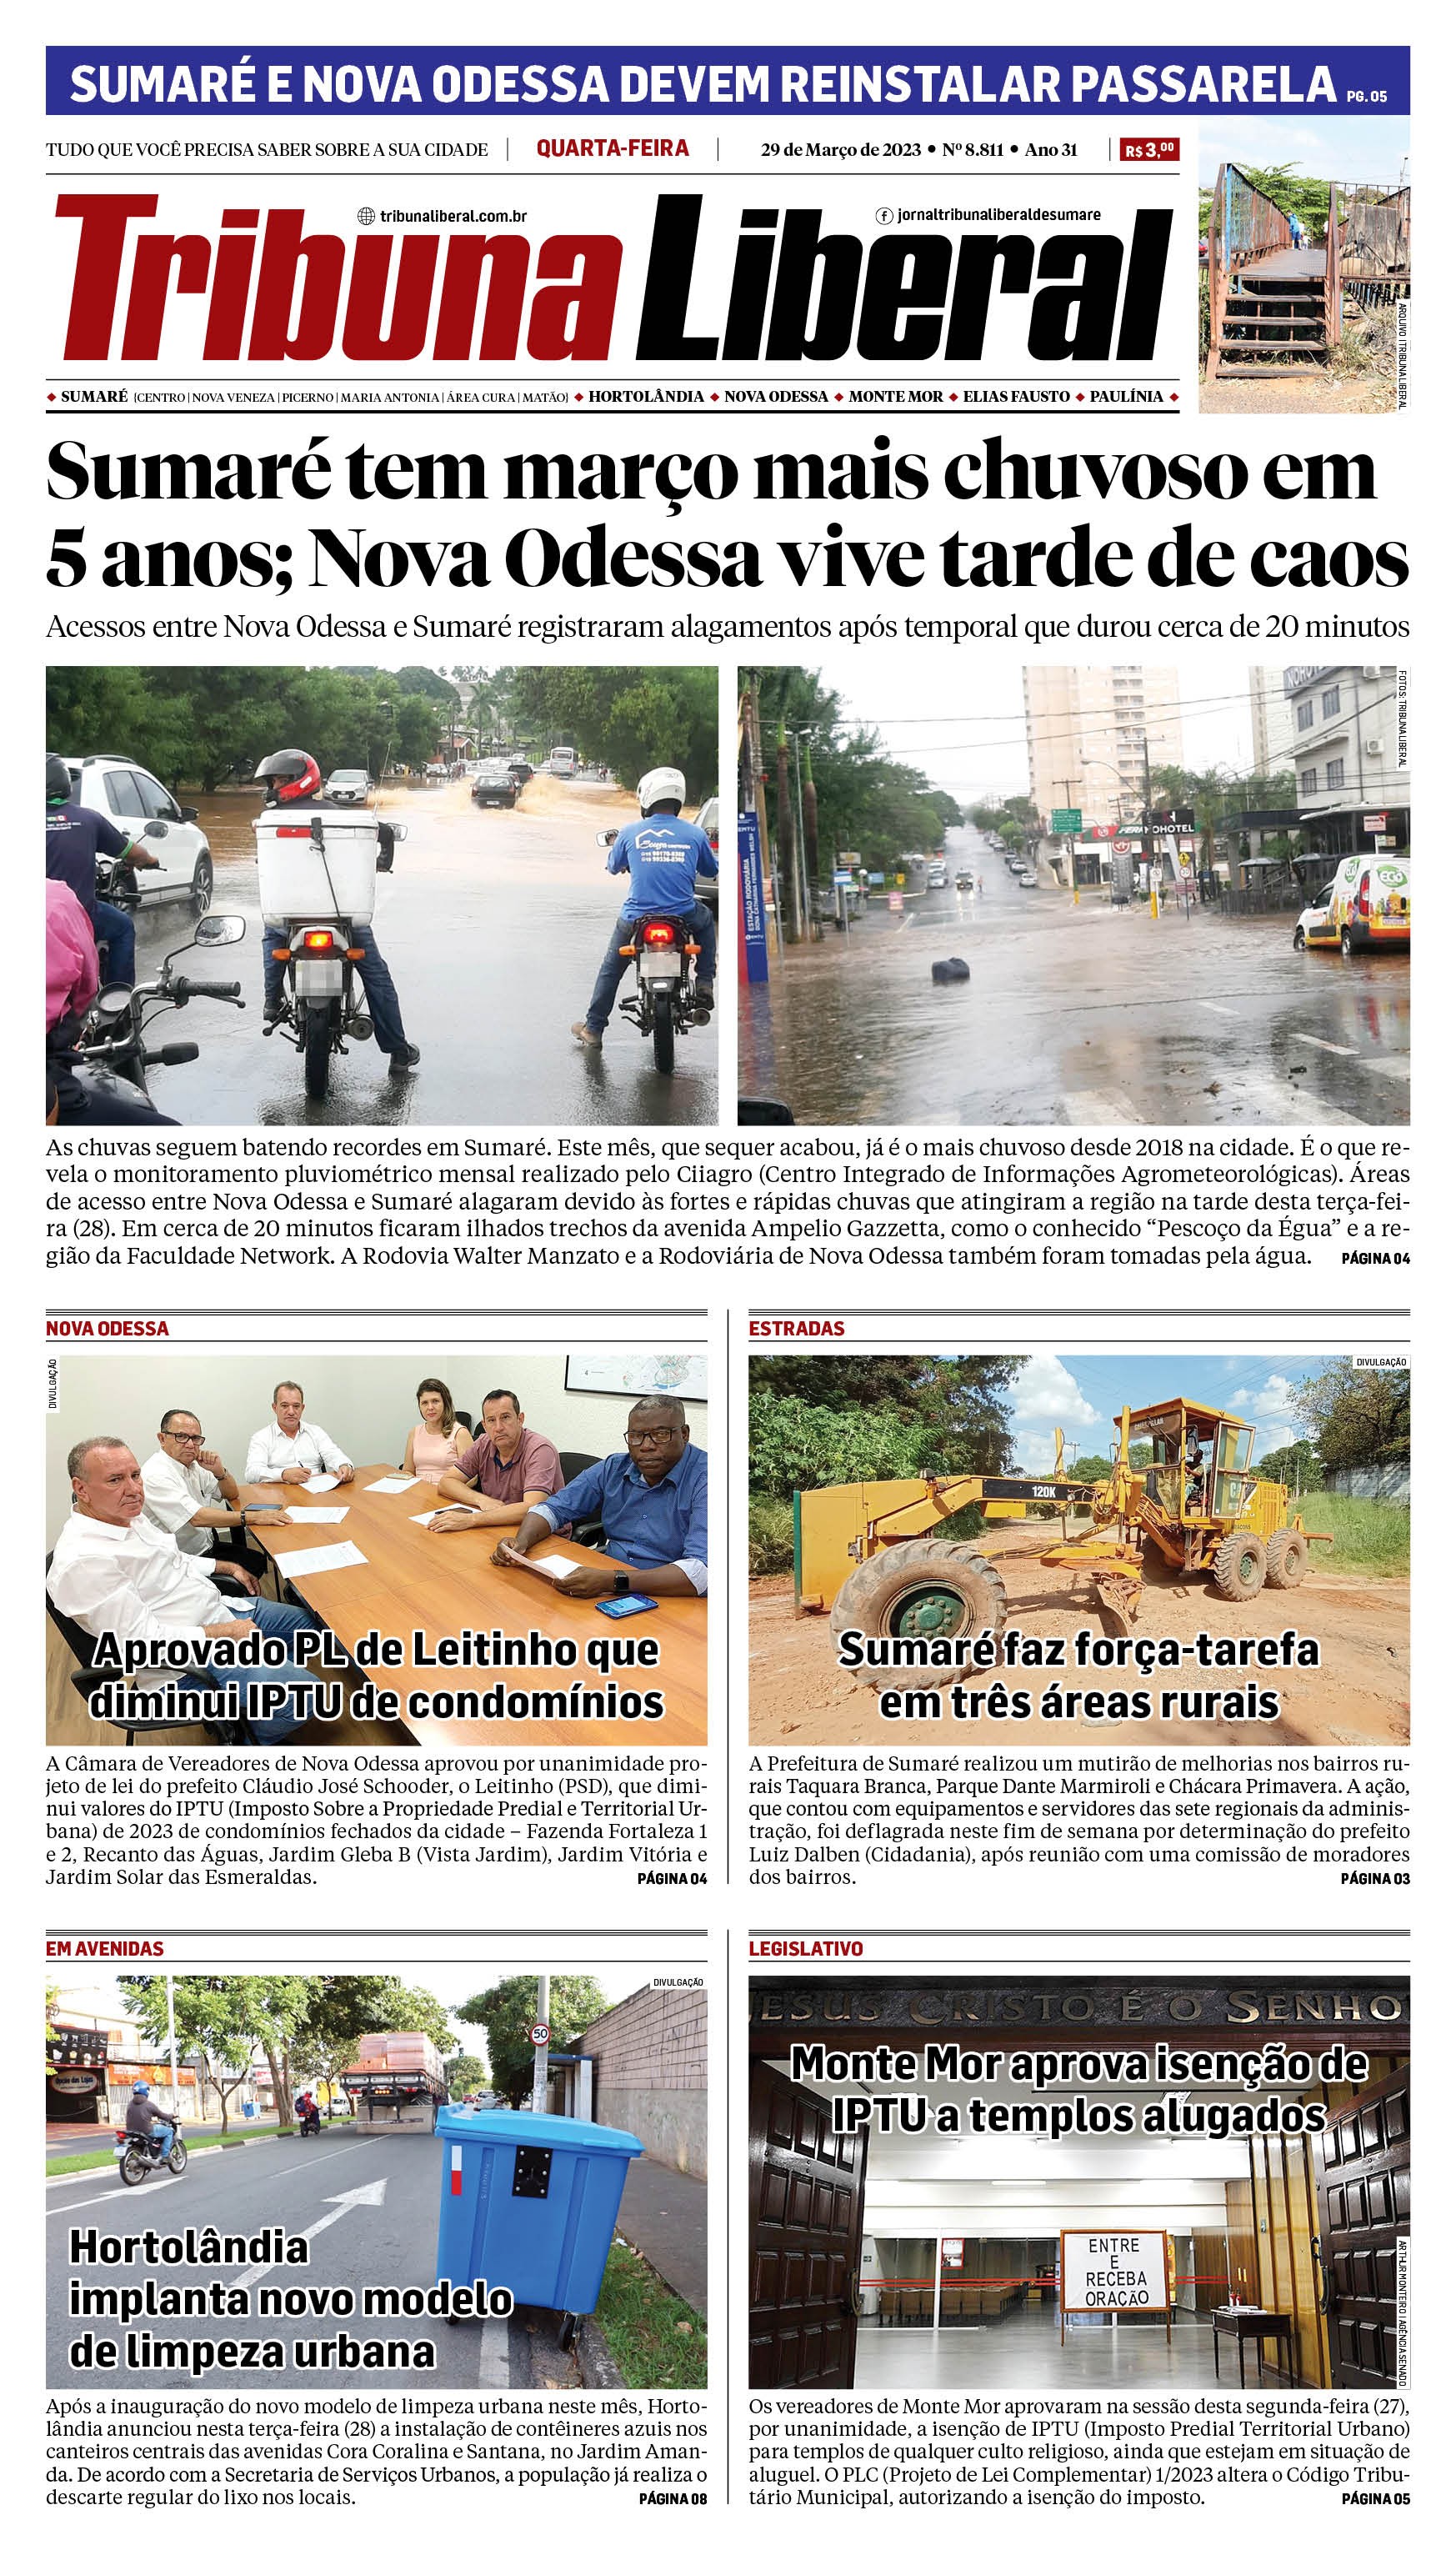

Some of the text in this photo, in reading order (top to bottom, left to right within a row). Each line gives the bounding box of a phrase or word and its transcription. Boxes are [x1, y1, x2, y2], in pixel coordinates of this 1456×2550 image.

[71, 56, 1388, 103] SUMARÉ E NOVA ODESSA DEVEM REINSTALAR PASSARELA PG. 05
[538, 139, 689, 158] QUARTA-FEIRA
[761, 143, 1077, 160] 29 de Março de 2023 Nº 8.811 Ano 31
[1126, 143, 1174, 159] R$ 3,00
[380, 209, 527, 223] tribunaliberal.com.br
[897, 208, 1101, 223] jornaltribunaliberaldesumare
[55, 194, 1173, 360] Tribuna Liberal
[62, 388, 128, 402] SUMARÉ
[193, 393, 224, 403] NOVA
[228, 393, 274, 403] VENEZA
[283, 393, 333, 403] PICERNO
[341, 393, 381, 403] MARIA
[384, 393, 440, 403] ANTONIA
[447, 391, 479, 403] ÁREA
[483, 393, 515, 403] CURA
[589, 388, 704, 403] HORTOLÂNDIA
[725, 391, 766, 403] NOVA
[769, 391, 828, 403] ODESSA
[848, 391, 906, 403] MONTE
[909, 391, 944, 403] MOR
[963, 391, 1008, 403] ELIAS
[1011, 391, 1070, 403] FAUSTO
[1089, 388, 1163, 403] PAULÍNIA
[48, 435, 1378, 515] Sumaré tem março mais chuvoso em
[47, 523, 1408, 597] 5 anos; Nova Odessa vive tarde de caos
[743, 858, 755, 932] ESTAÇÃO RODOVIÁRIA
[47, 1321, 169, 1336] NOVA ODESSA
[749, 1321, 844, 1336] ESTRADAS
[1032, 1485, 1056, 1498] 120K
[749, 1869, 1411, 1886] dos bairros. PÁGINA 03
[47, 1941, 164, 1956] EM AVENIDAS
[749, 1941, 863, 1956] LEGISLATIVO
[909, 1992, 1095, 2025] CRISTO
[1121, 1989, 1143, 2021] É
[1168, 1995, 1203, 2021] O
[534, 2028, 548, 2039] 50
[1088, 2237, 1140, 2252] ENTRE
[1110, 2255, 1118, 2269] E
[1086, 2271, 1148, 2287] RECEBA
[1085, 2290, 1149, 2307] ORAÇÃO
[47, 2489, 708, 2509] descarte regular do lixo nos locais. PÁGINA 08
[1343, 2491, 1411, 2506] PÁGINA 05
